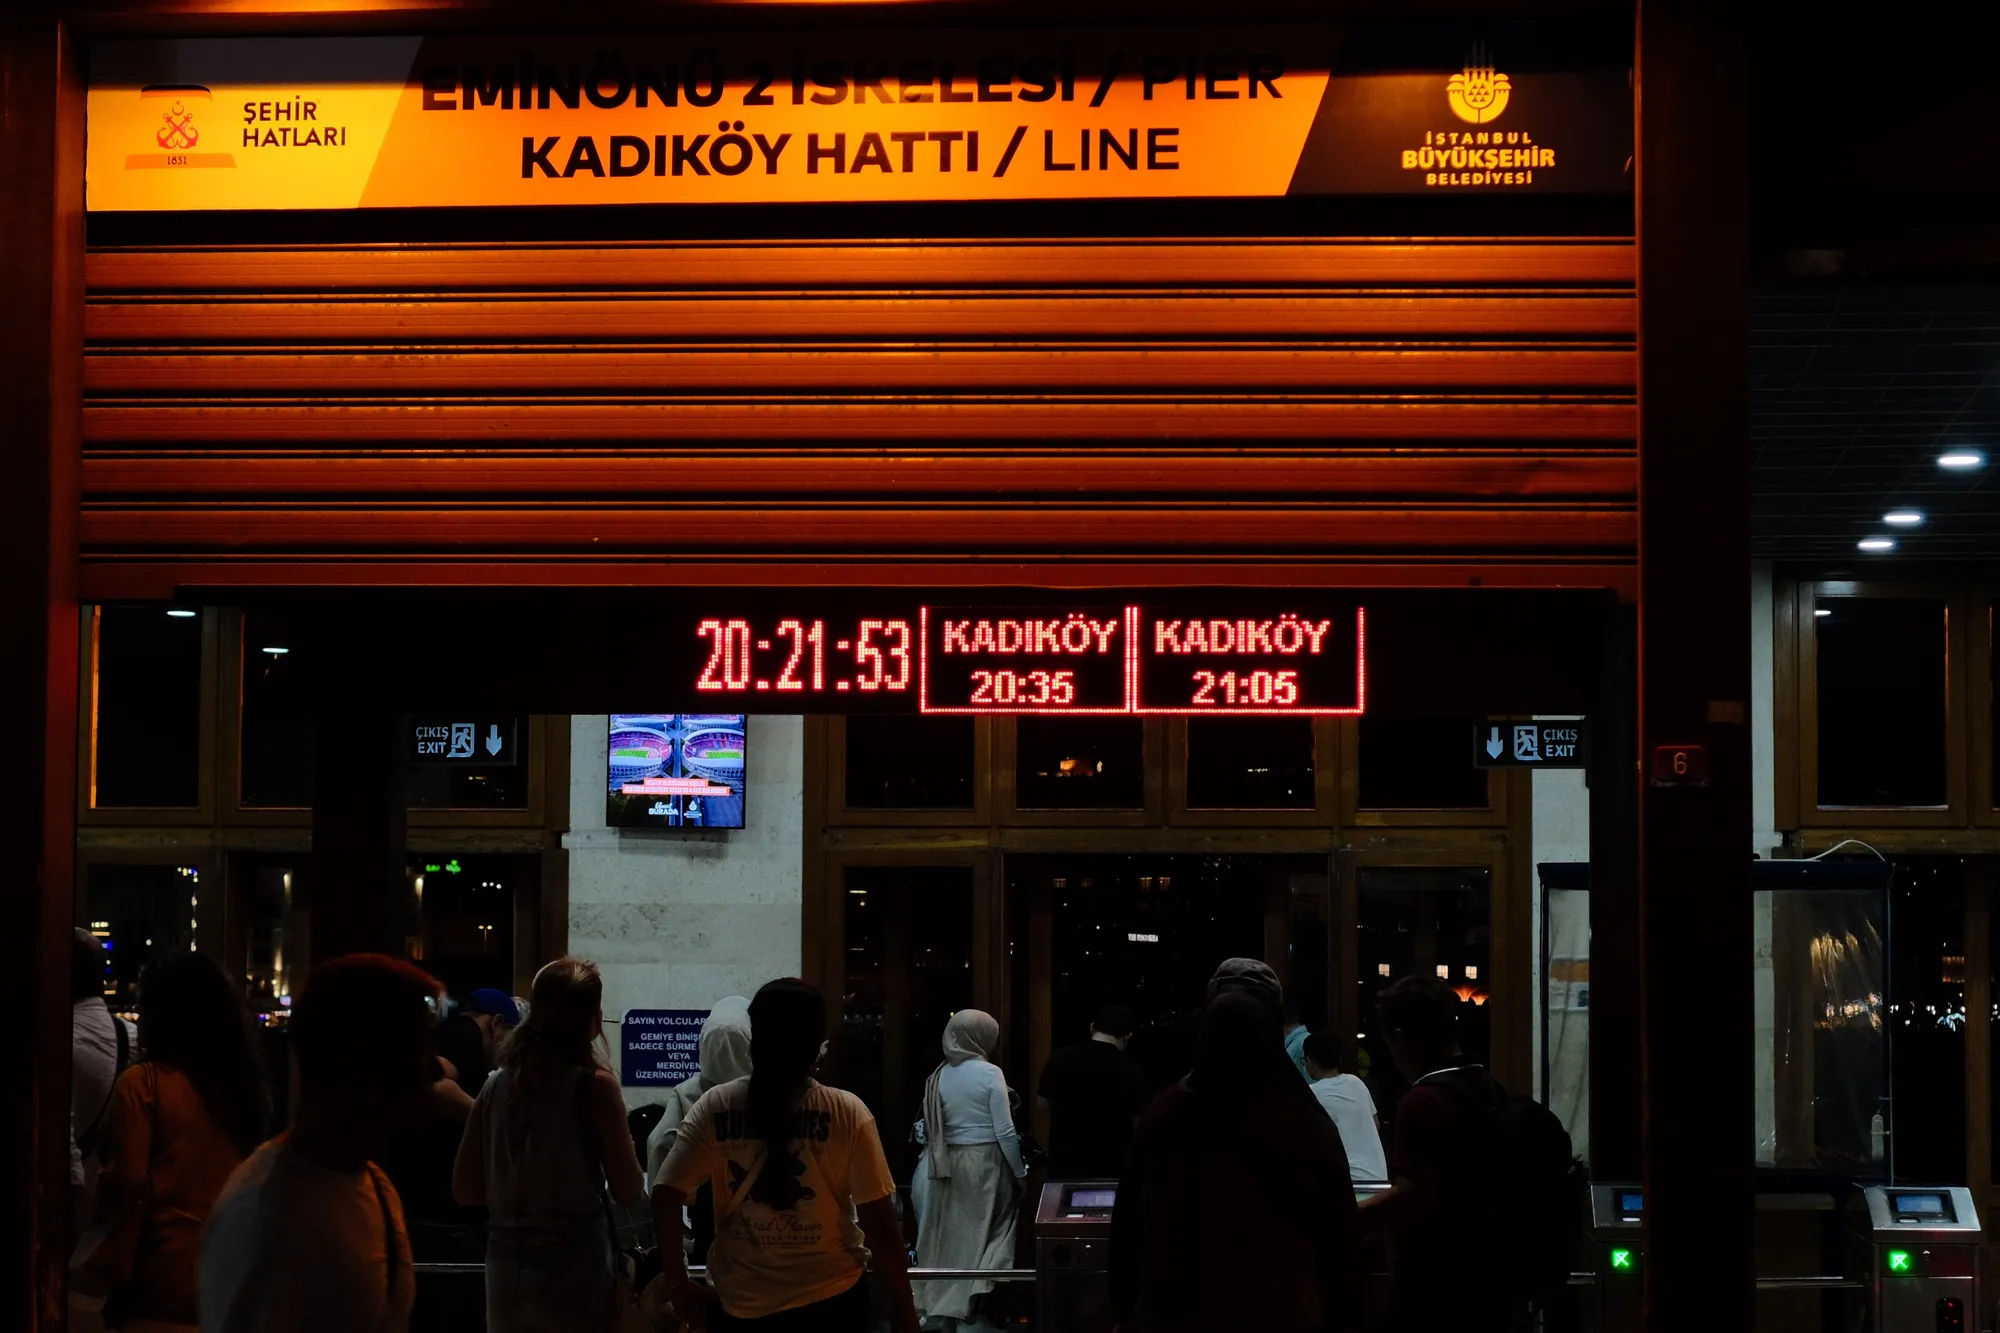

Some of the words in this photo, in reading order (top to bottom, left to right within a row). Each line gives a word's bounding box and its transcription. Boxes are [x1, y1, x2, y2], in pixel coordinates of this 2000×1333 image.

[422, 48, 726, 111] EMİNÖNÜ
[742, 62, 774, 107] 2
[791, 40, 1075, 107] İSKELESİ
[1089, 51, 1127, 108] /
[1143, 53, 1285, 101] PIER
[243, 95, 317, 125] ŞEHİR
[243, 127, 346, 148] HATLARI
[1426, 130, 1532, 146] İSTANBUL
[522, 120, 792, 178] KADIKÖY
[807, 131, 978, 174] HATTI
[993, 126, 1029, 177] /
[1044, 128, 1179, 171] LINE
[1402, 145, 1556, 169] BÜYÜKŞEHİR
[166, 156, 187, 166] 1851
[1425, 170, 1532, 186] BELEDİYESİ
[943, 613, 1119, 653] KADIKÖY
[1154, 613, 1331, 653] KADIKÖY
[697, 619, 911, 692] 20:21:53
[970, 670, 1076, 704] 20:35
[1192, 670, 1300, 704] 21:05
[416, 726, 449, 741] ÇIKIŞ
[1543, 729, 1578, 743] ÇIKIŞ
[418, 742, 446, 754] EXIT
[1545, 744, 1576, 757] EXIT
[1673, 752, 1688, 775] 6
[628, 1016, 655, 1025] SAYIN
[640, 1032, 674, 1041] GEMİYE
[676, 1032, 701, 1043] BİNİŞ
[628, 1042, 664, 1051] SADECE
[666, 1041, 697, 1051] SÜRME
[668, 1052, 691, 1060] VEYA
[635, 1069, 685, 1079] ÜZERİNDEN
